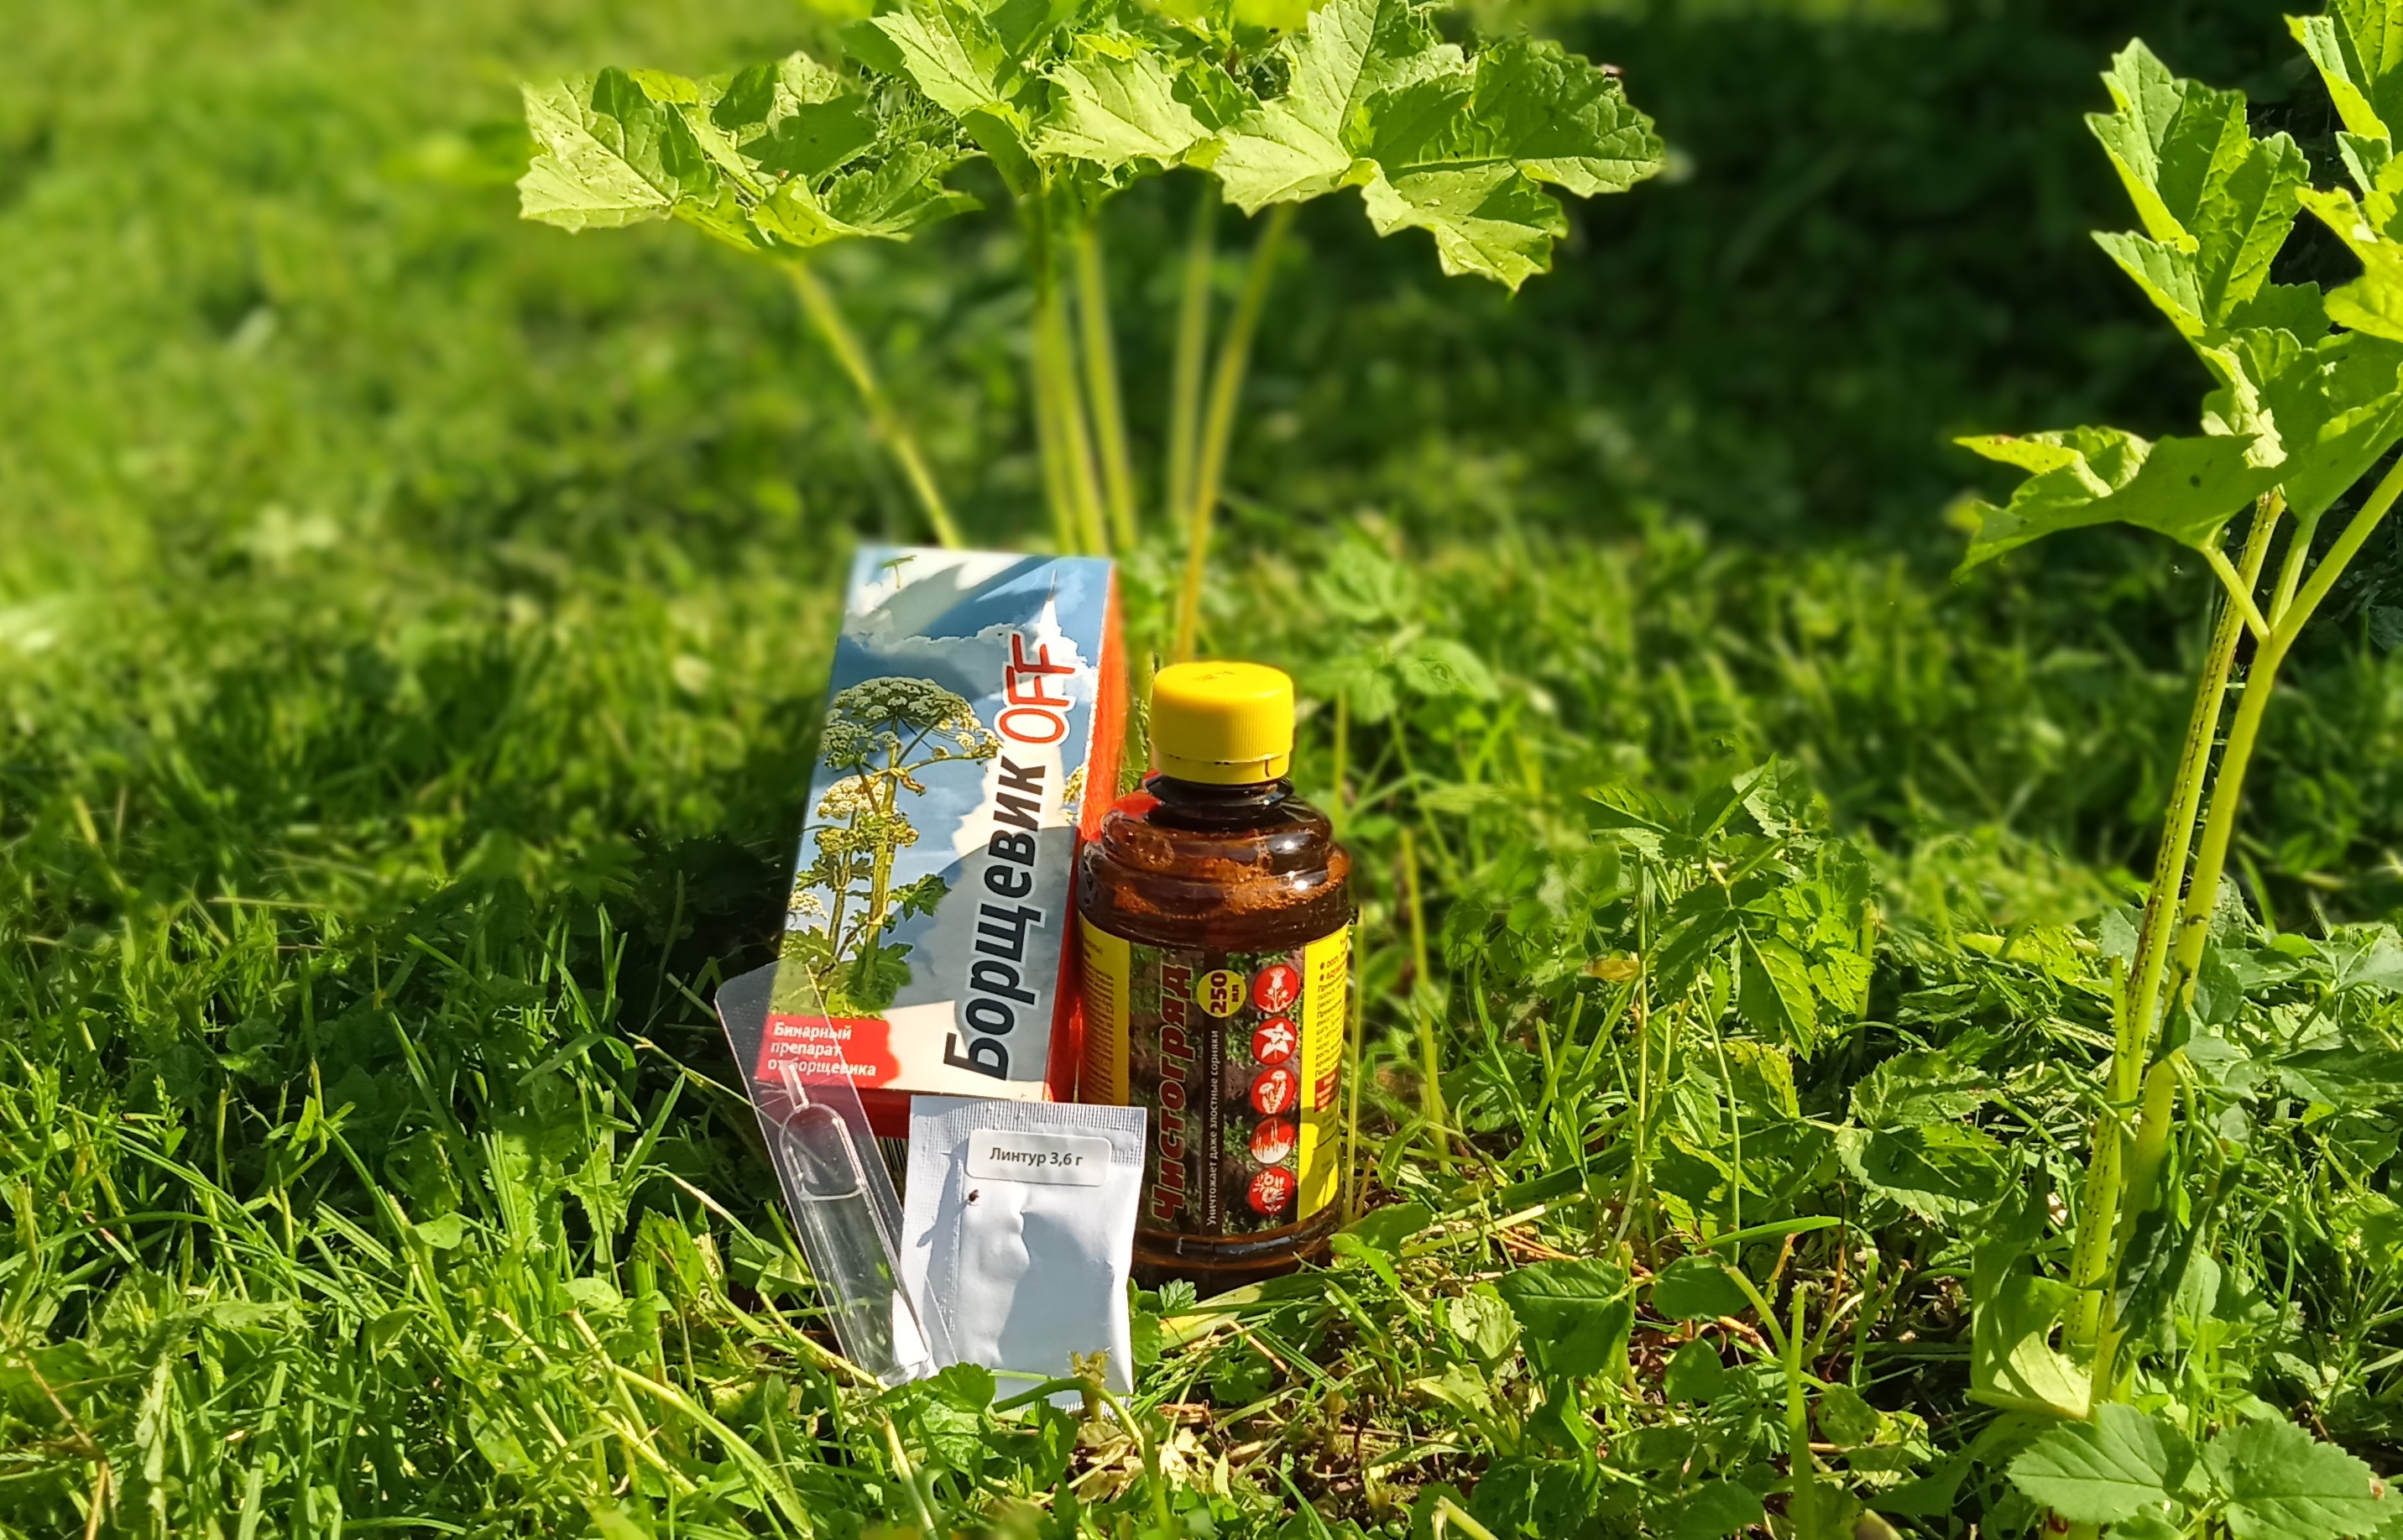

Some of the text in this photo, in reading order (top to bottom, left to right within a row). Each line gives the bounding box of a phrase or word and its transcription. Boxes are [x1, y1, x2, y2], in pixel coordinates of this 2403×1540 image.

[943, 632, 1075, 1081] Борщевик OFF
[1210, 972, 1227, 1013] 250
[770, 1041, 842, 1059] препарат
[773, 1021, 852, 1041] Бинарный
[1151, 960, 1195, 1221] Чистогряд
[1206, 1030, 1221, 1225] Уничтожает даже злостные сорняки
[990, 1146, 1084, 1167] Линтур 3,6 г
